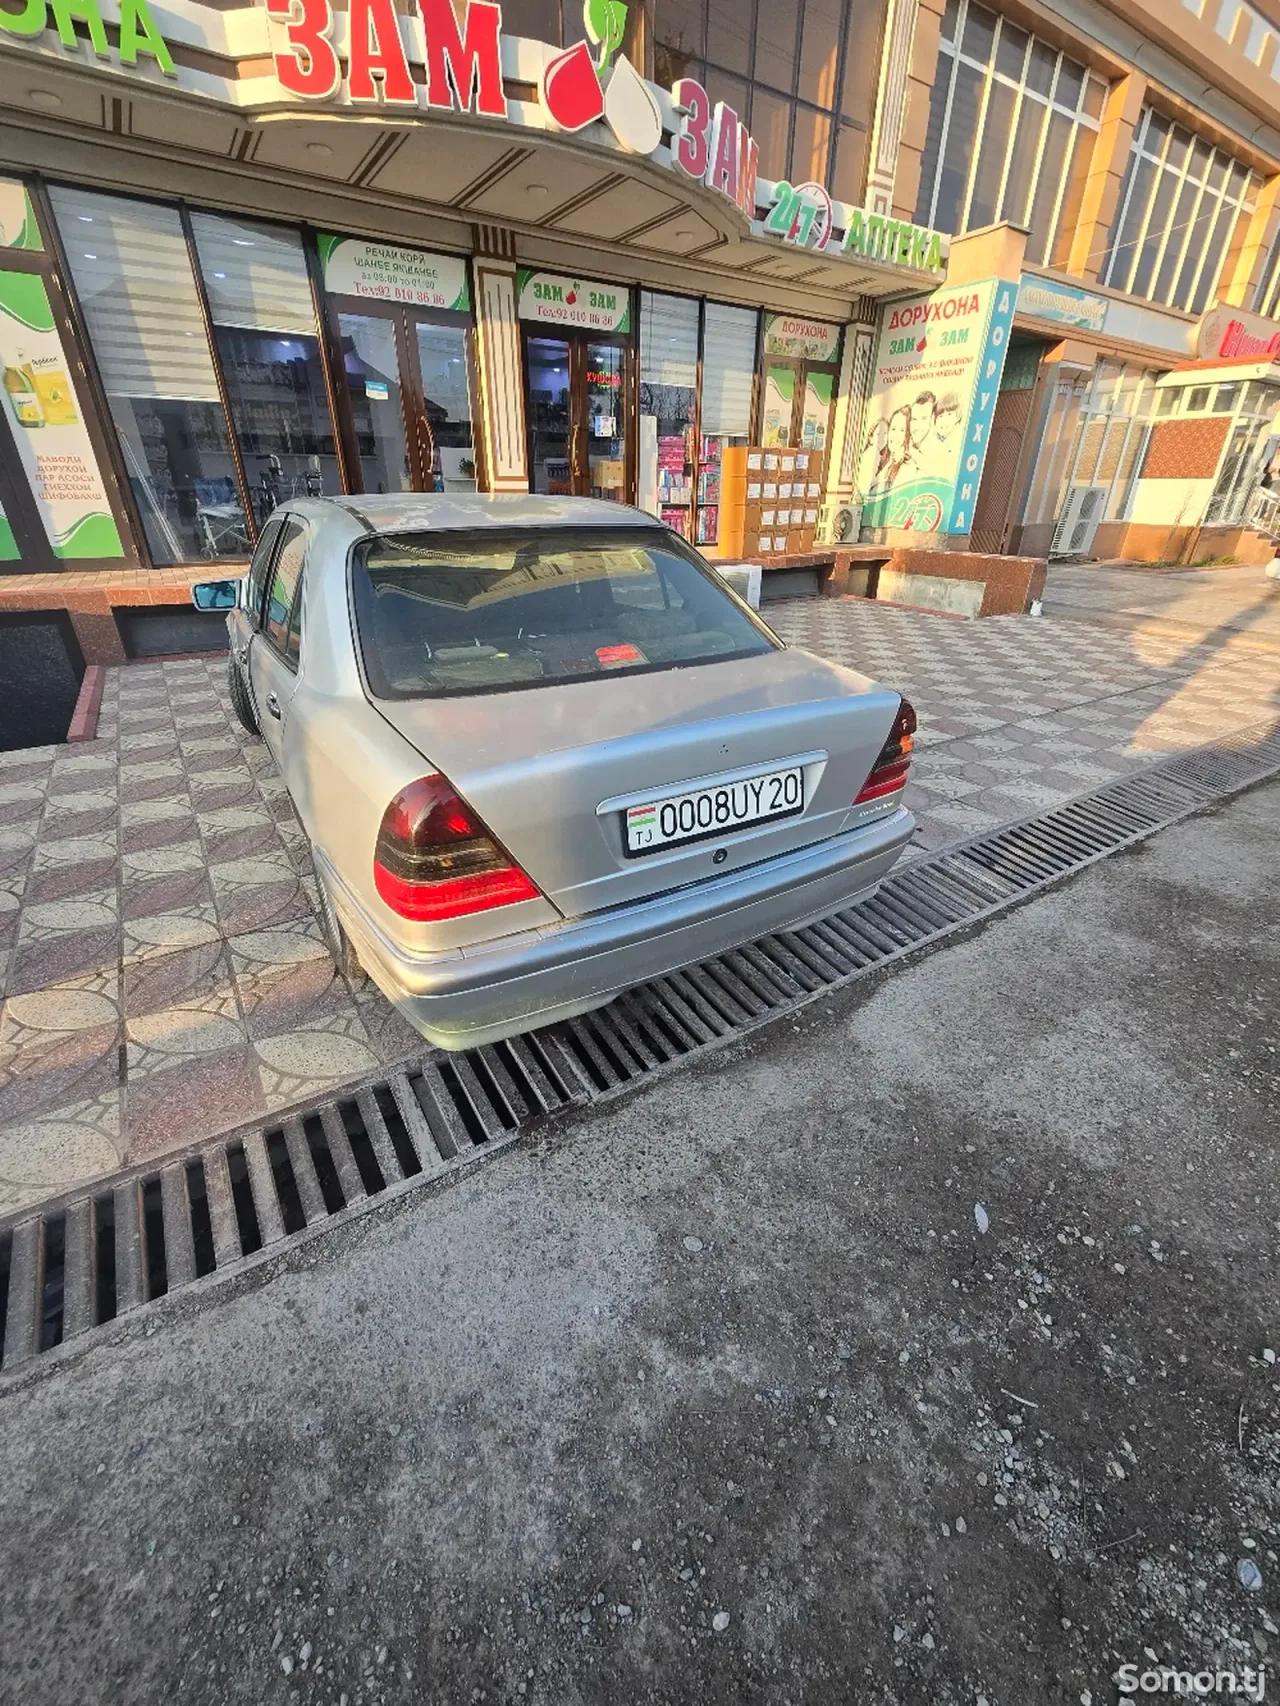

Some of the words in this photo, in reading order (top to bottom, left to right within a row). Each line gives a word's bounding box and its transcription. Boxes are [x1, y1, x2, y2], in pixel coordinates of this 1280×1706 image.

[266, 0, 508, 118] ЗАМ
[673, 78, 760, 222] ЗАМ
[846, 210, 942, 273] АПТЕКА
[354, 256, 391, 271] ШАНБЕ
[395, 288, 413, 300] 010
[533, 282, 564, 303] ЗАМ
[589, 291, 617, 310] ЗАМ
[888, 293, 980, 331] ДОРУХОНА
[781, 320, 828, 340] ДОРУХОНА
[888, 336, 916, 355] ЗАМ
[939, 327, 970, 347] ЗАМ
[959, 290, 1010, 529] ДОРУХОНА
[635, 828, 653, 846] TJ
